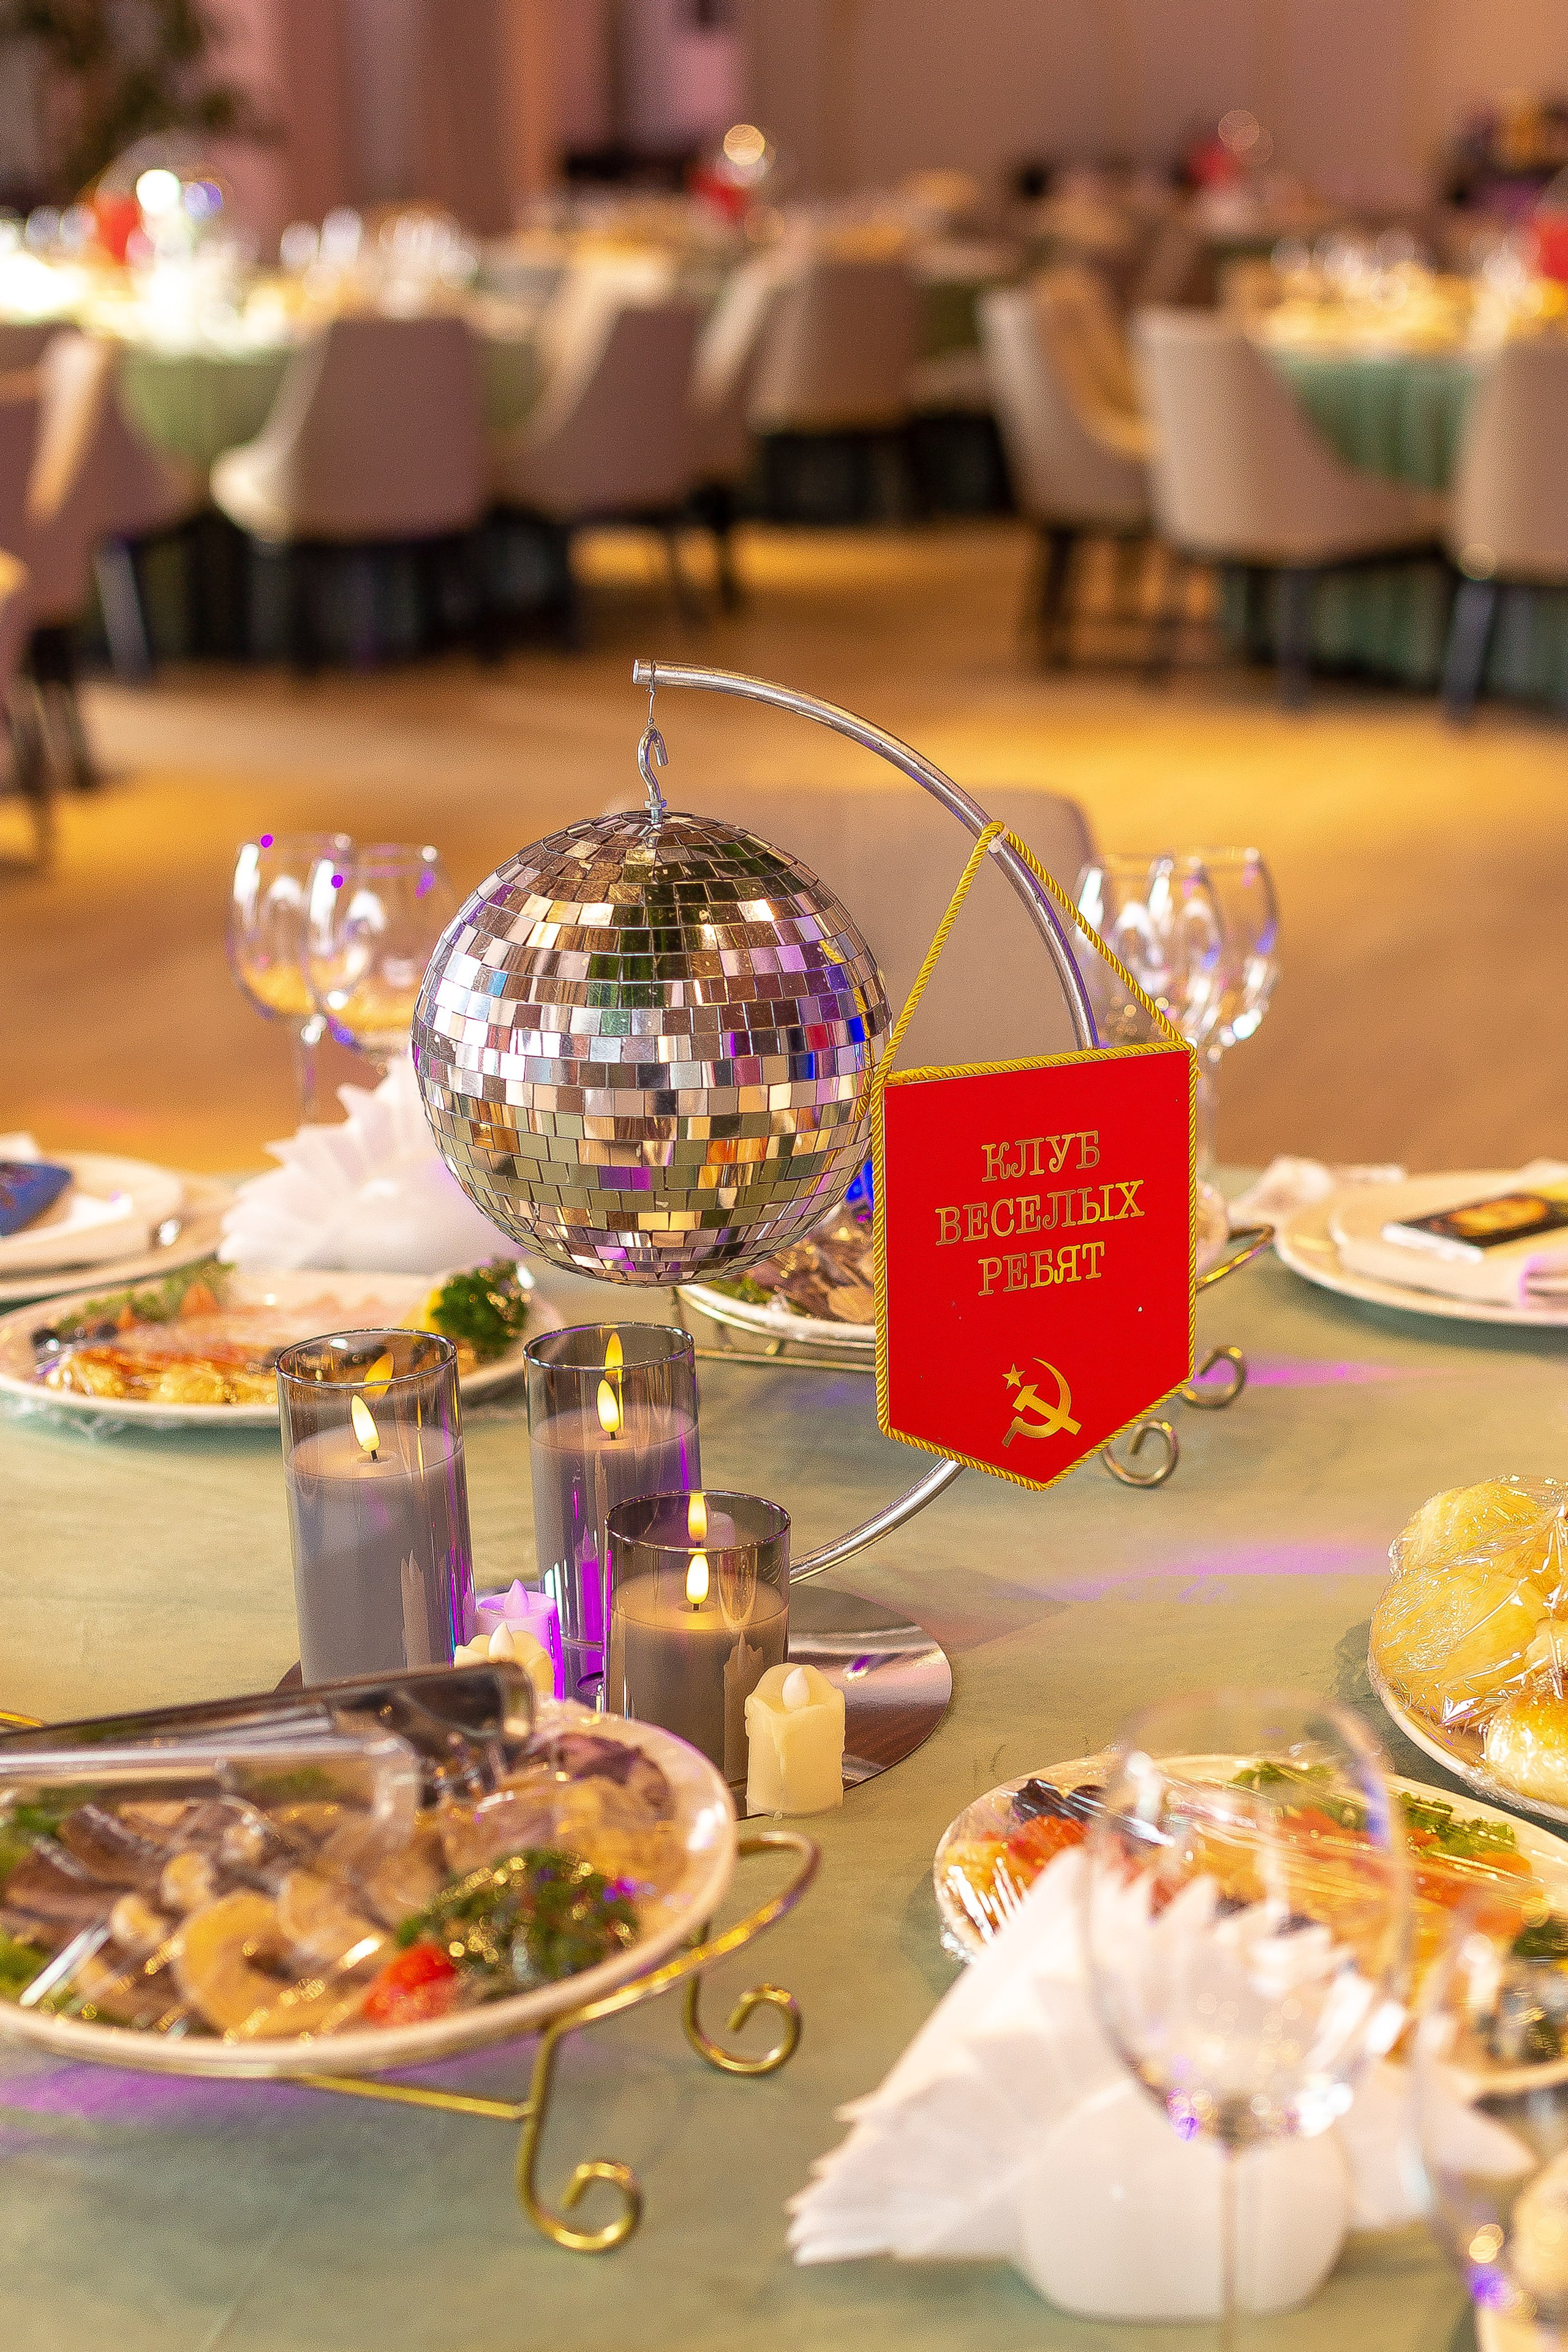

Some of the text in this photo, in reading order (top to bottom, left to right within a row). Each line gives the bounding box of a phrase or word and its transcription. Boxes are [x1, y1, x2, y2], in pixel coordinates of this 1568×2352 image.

[981, 1130, 1101, 1183] КЛУБ
[935, 1180, 1145, 1246] ВЕСЕЛЫХ
[978, 1242, 1105, 1296] РЕБЯТ
